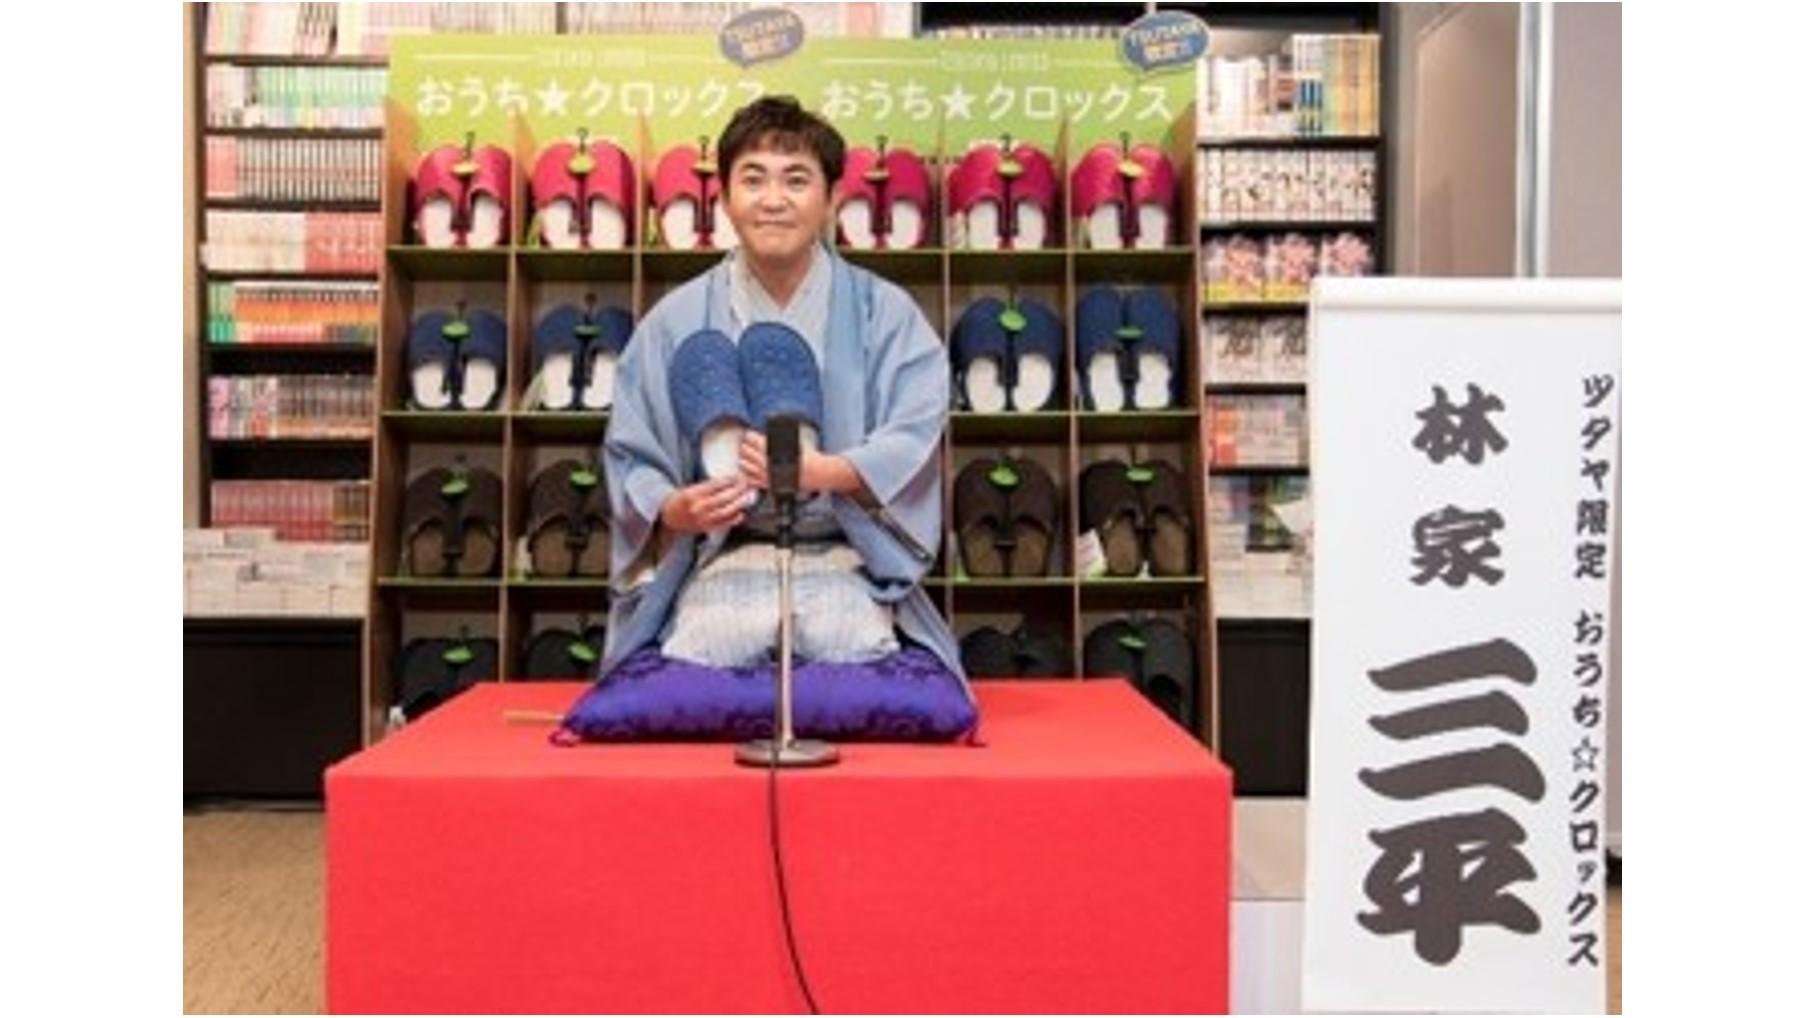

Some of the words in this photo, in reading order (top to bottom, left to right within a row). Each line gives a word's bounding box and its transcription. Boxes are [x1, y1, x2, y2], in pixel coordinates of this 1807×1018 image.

[821, 80, 1173, 121] おうち★クロックス
